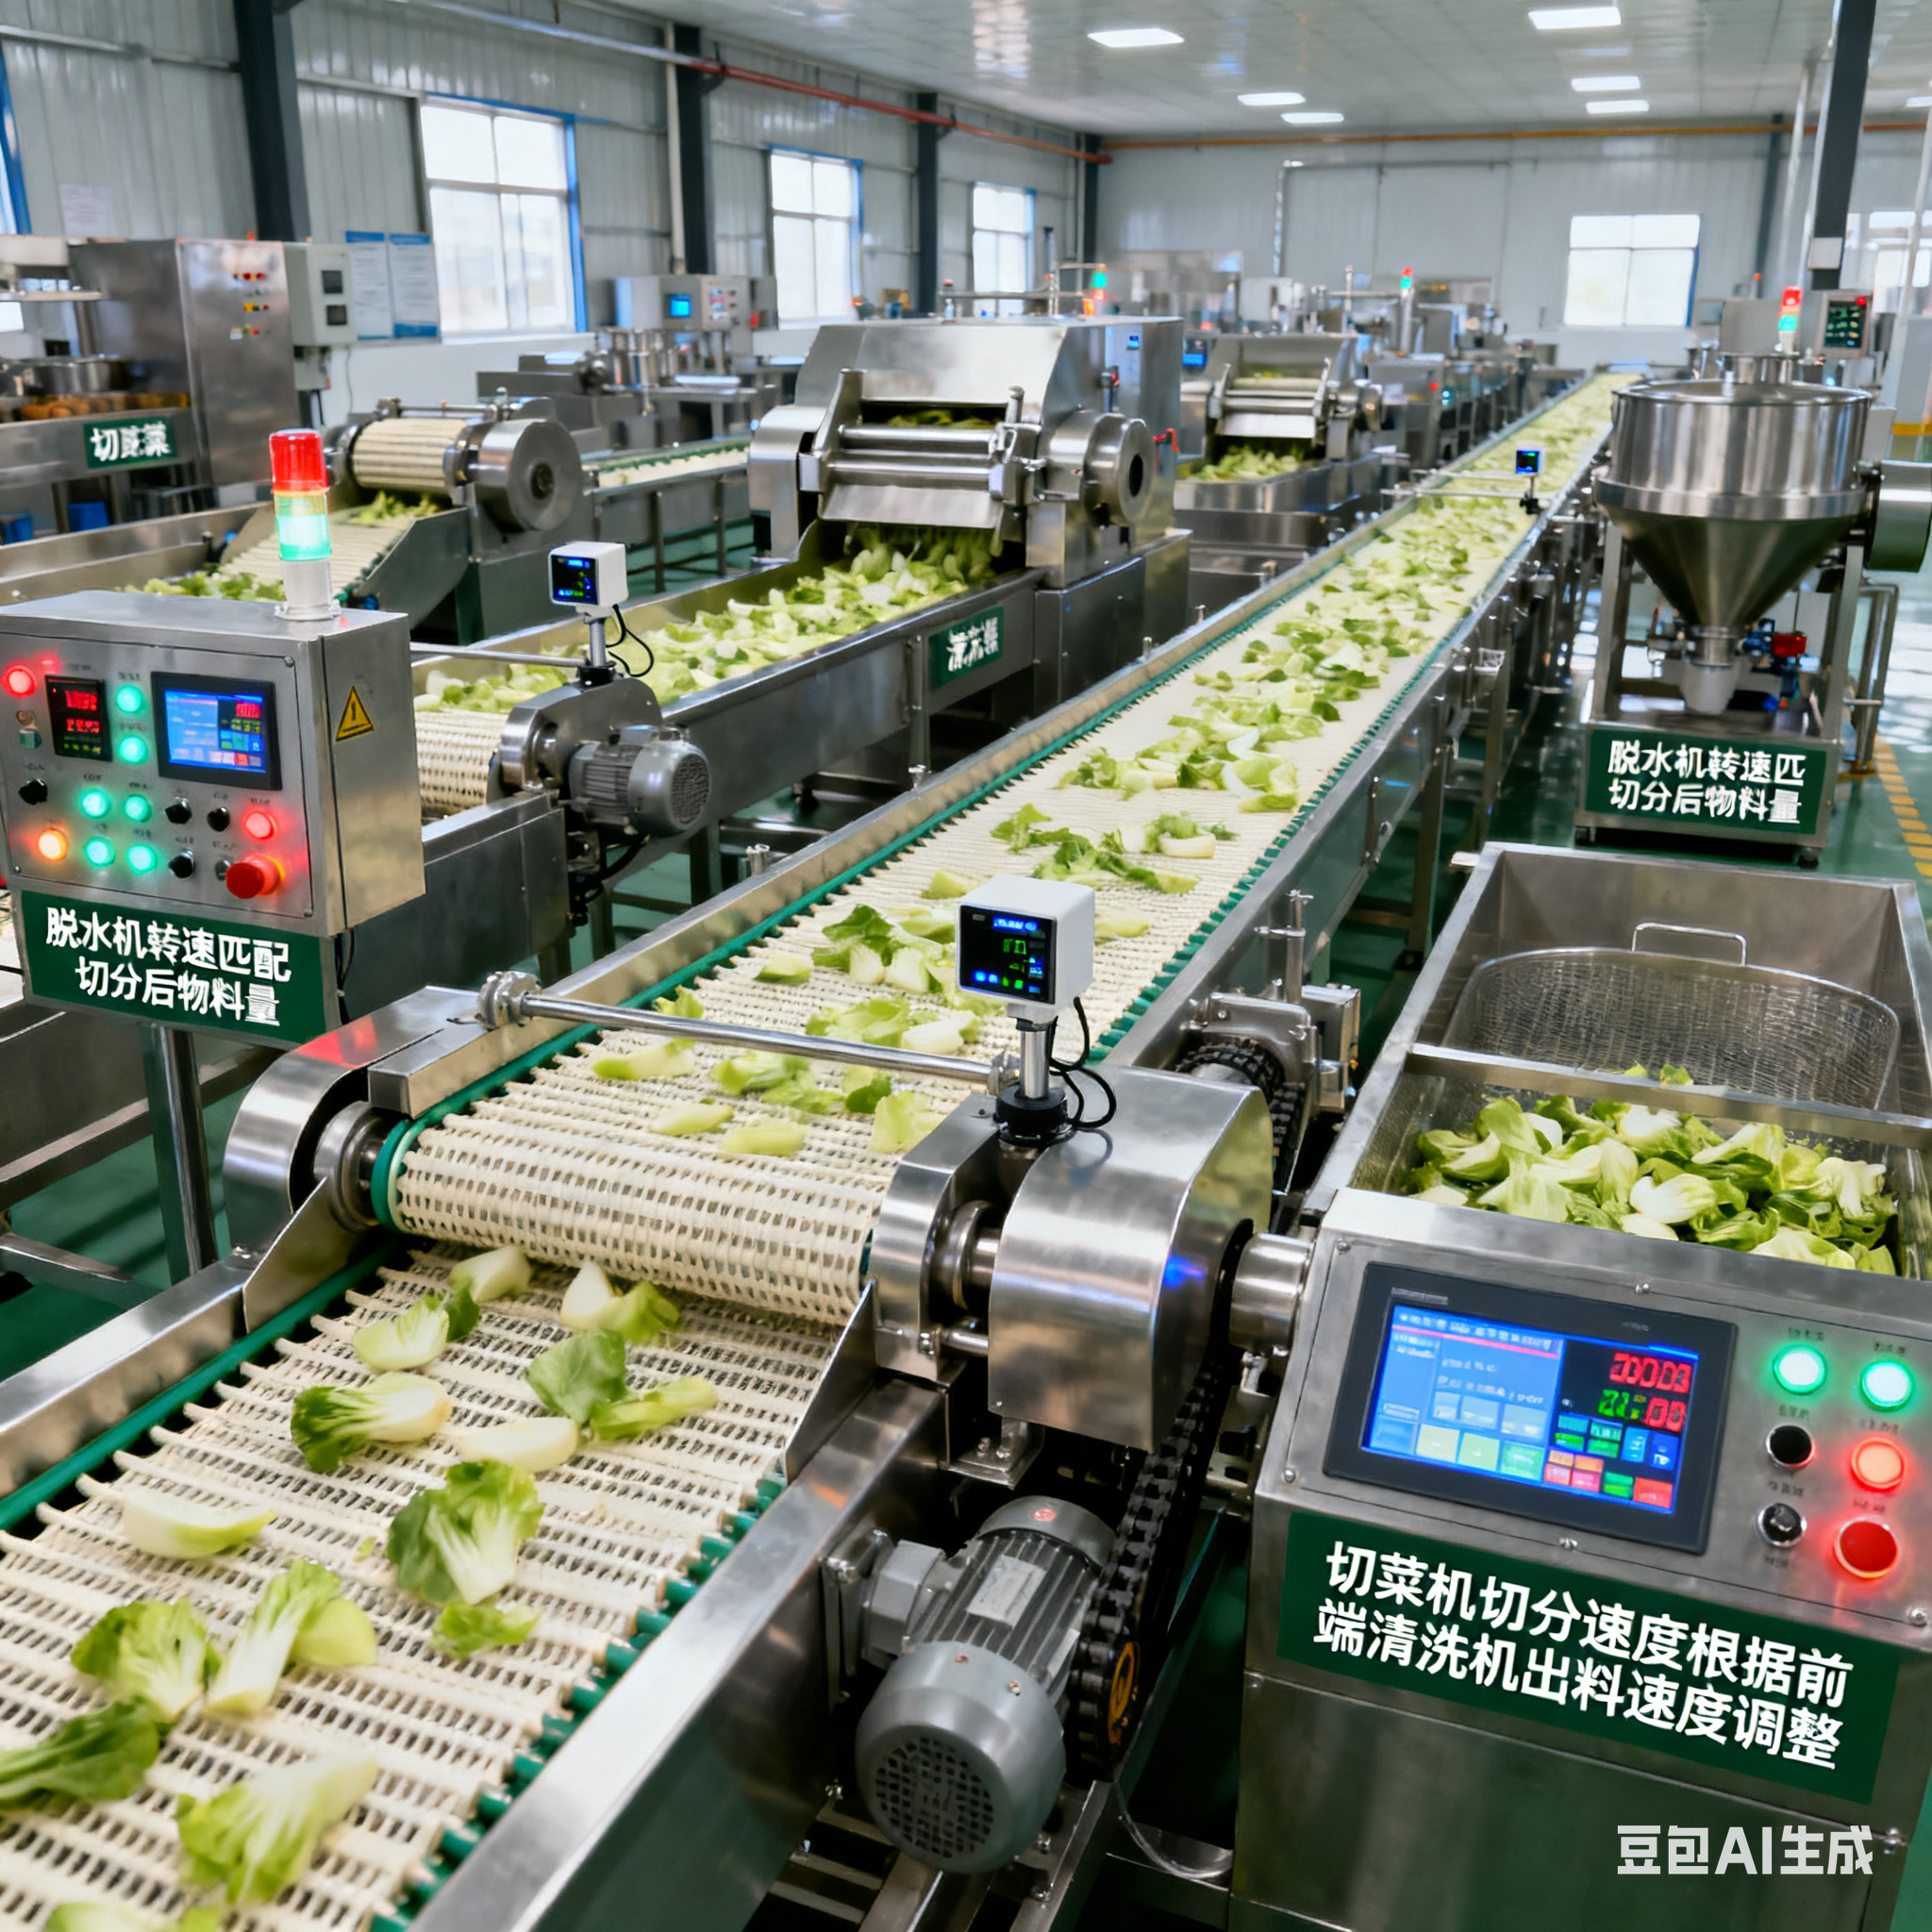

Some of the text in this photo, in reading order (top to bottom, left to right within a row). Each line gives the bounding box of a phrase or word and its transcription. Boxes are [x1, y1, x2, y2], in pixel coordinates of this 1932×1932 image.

[1607, 740, 1807, 787] 脱水机转速匹
[1608, 777, 1802, 824] 切分后物料量
[46, 907, 291, 982] 脱水机转速匹配
[75, 956, 280, 1026] 切分后物料量
[1326, 1541, 1854, 1707] 切菜机切分速度根据前
[1313, 1598, 1843, 1770] 端清洗机出料速度调整
